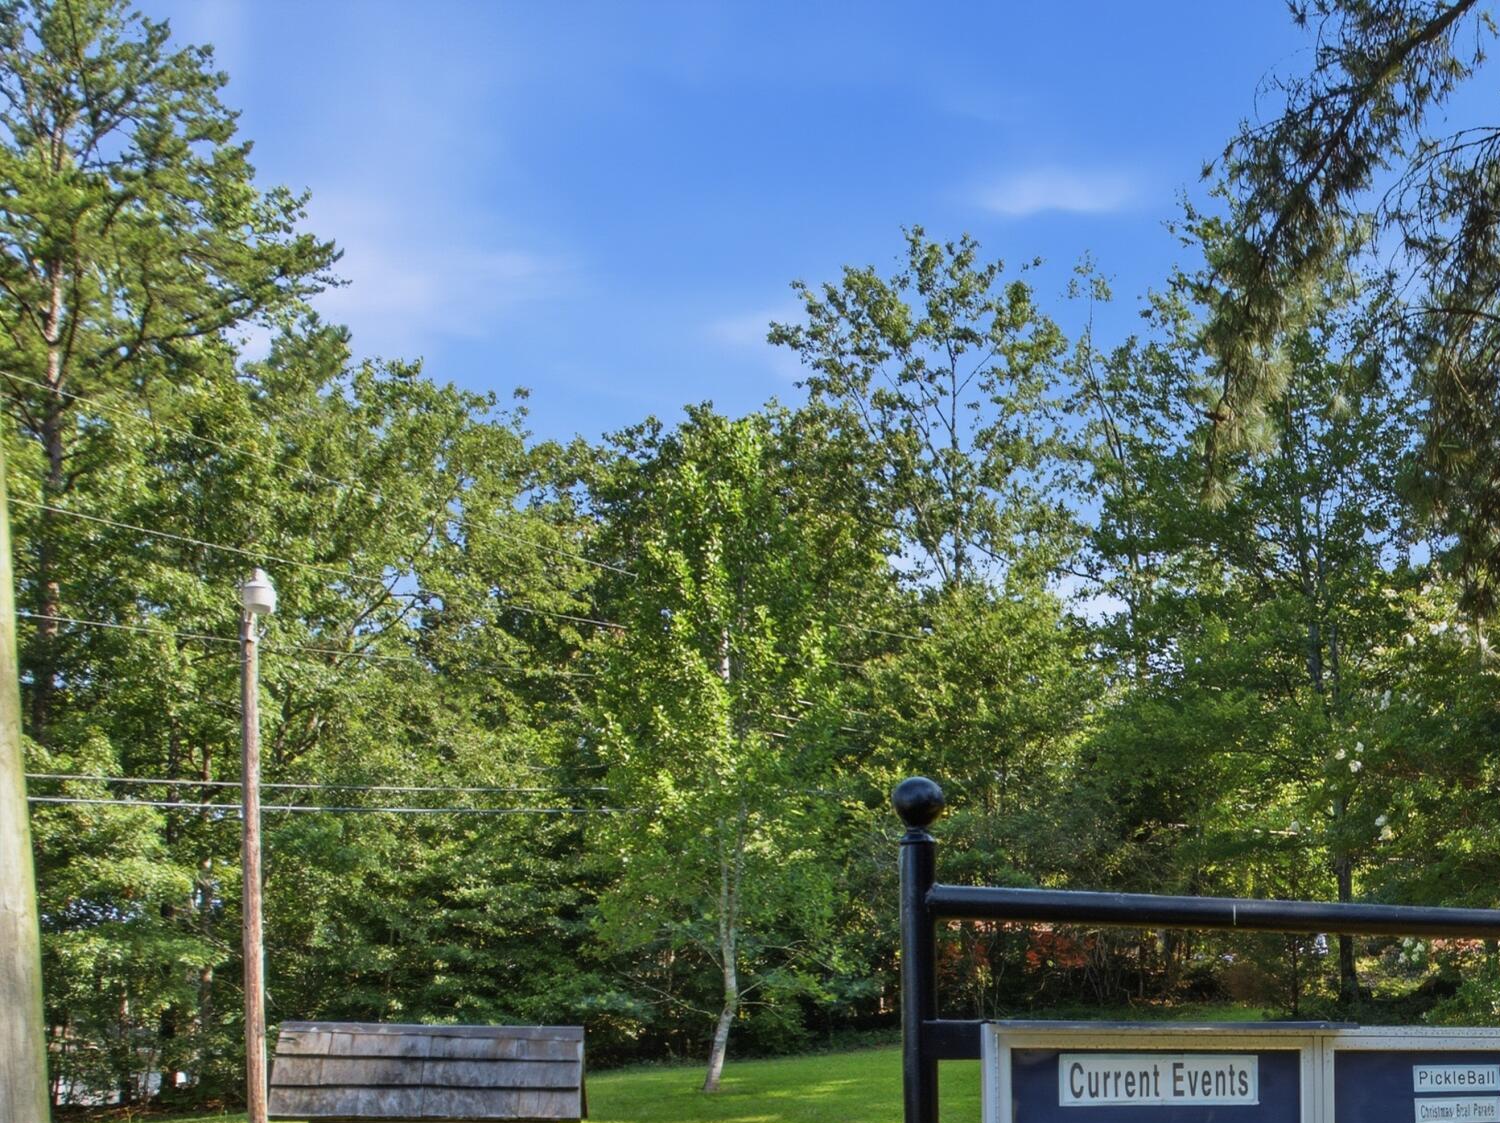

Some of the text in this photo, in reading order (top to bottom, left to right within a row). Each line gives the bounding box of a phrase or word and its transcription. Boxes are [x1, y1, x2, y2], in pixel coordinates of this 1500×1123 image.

[1069, 1061, 1250, 1099] Current Events
[1418, 1070, 1495, 1086] PickleBall
[1420, 1104, 1454, 1119] Christmas
[1473, 1102, 1495, 1117] Parade
